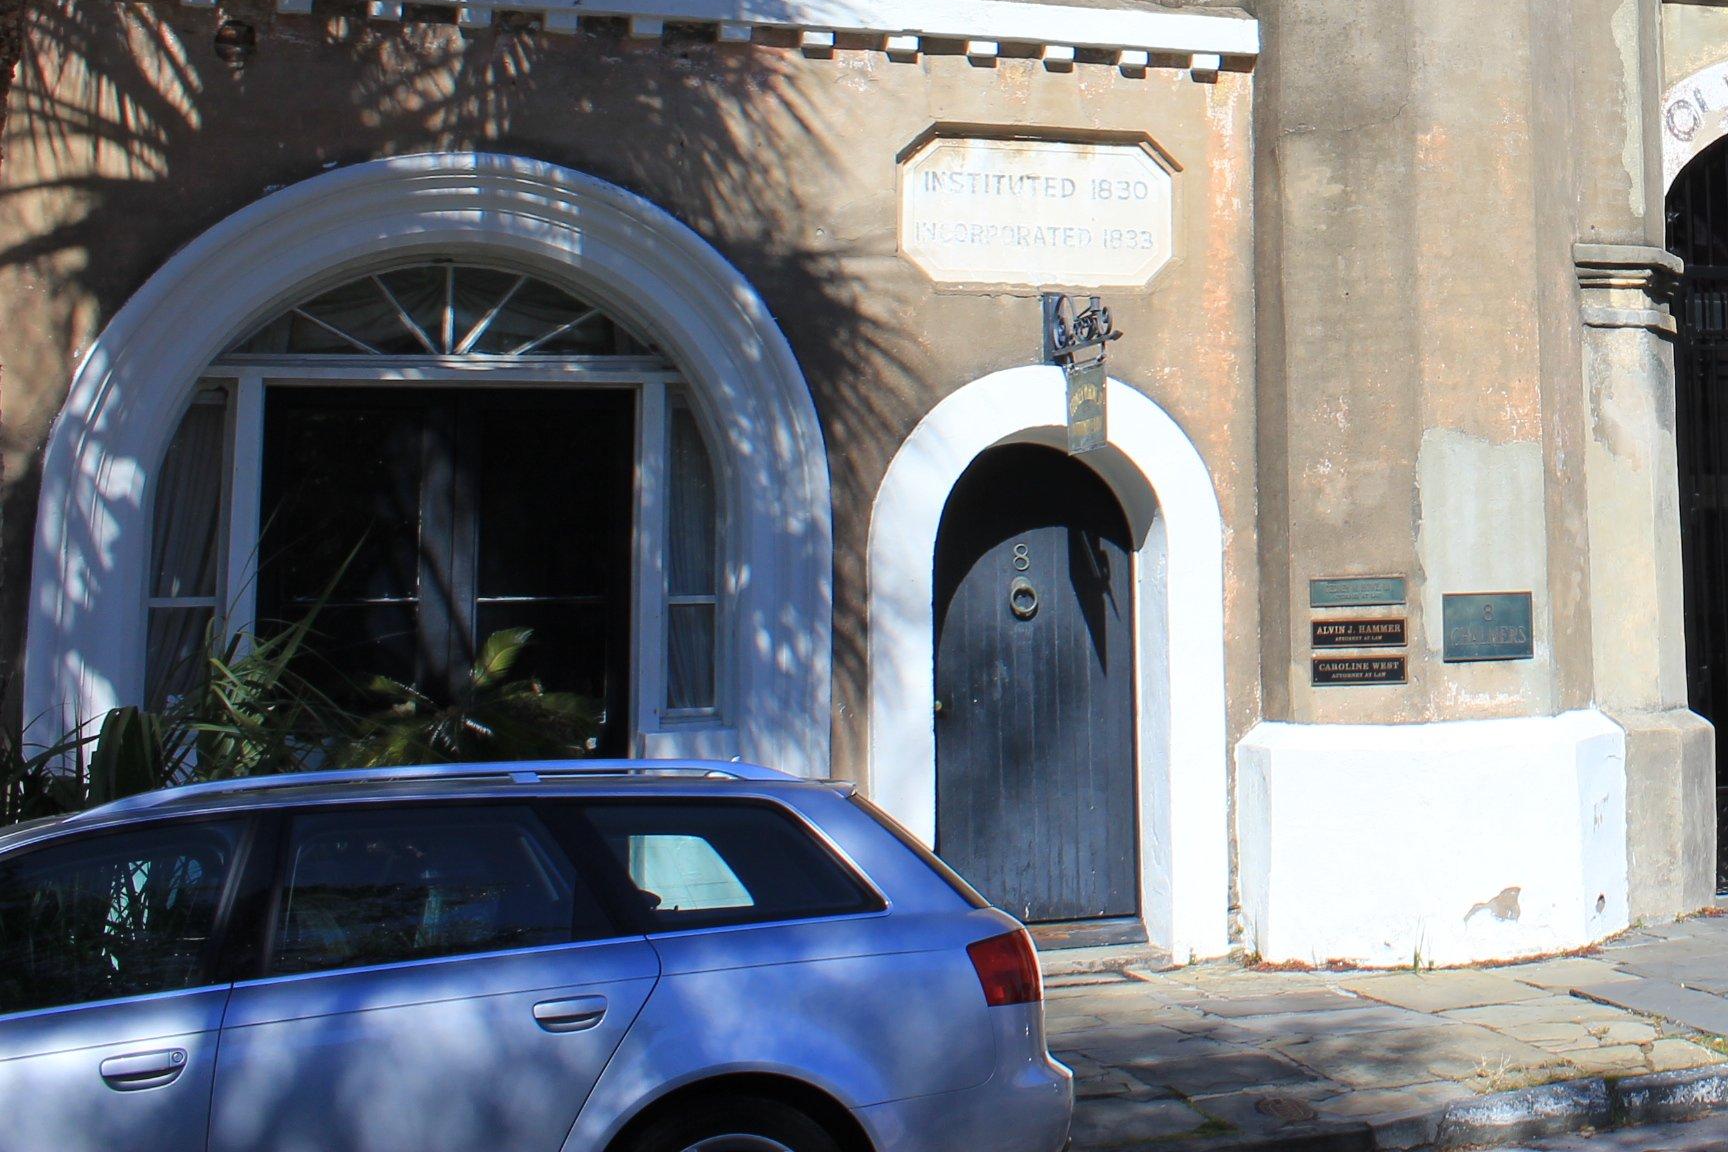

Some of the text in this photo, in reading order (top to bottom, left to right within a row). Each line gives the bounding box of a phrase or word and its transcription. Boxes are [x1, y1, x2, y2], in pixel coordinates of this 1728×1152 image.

[923, 170, 1149, 201] INSTITUTED 1830
[914, 221, 1155, 251] INCORPORATED 1833
[1013, 543, 1030, 571] 8
[1316, 625, 1346, 635] ALVIN
[1358, 623, 1401, 634] HAMMER
[1318, 660, 1400, 672] CAROLINE WEST
